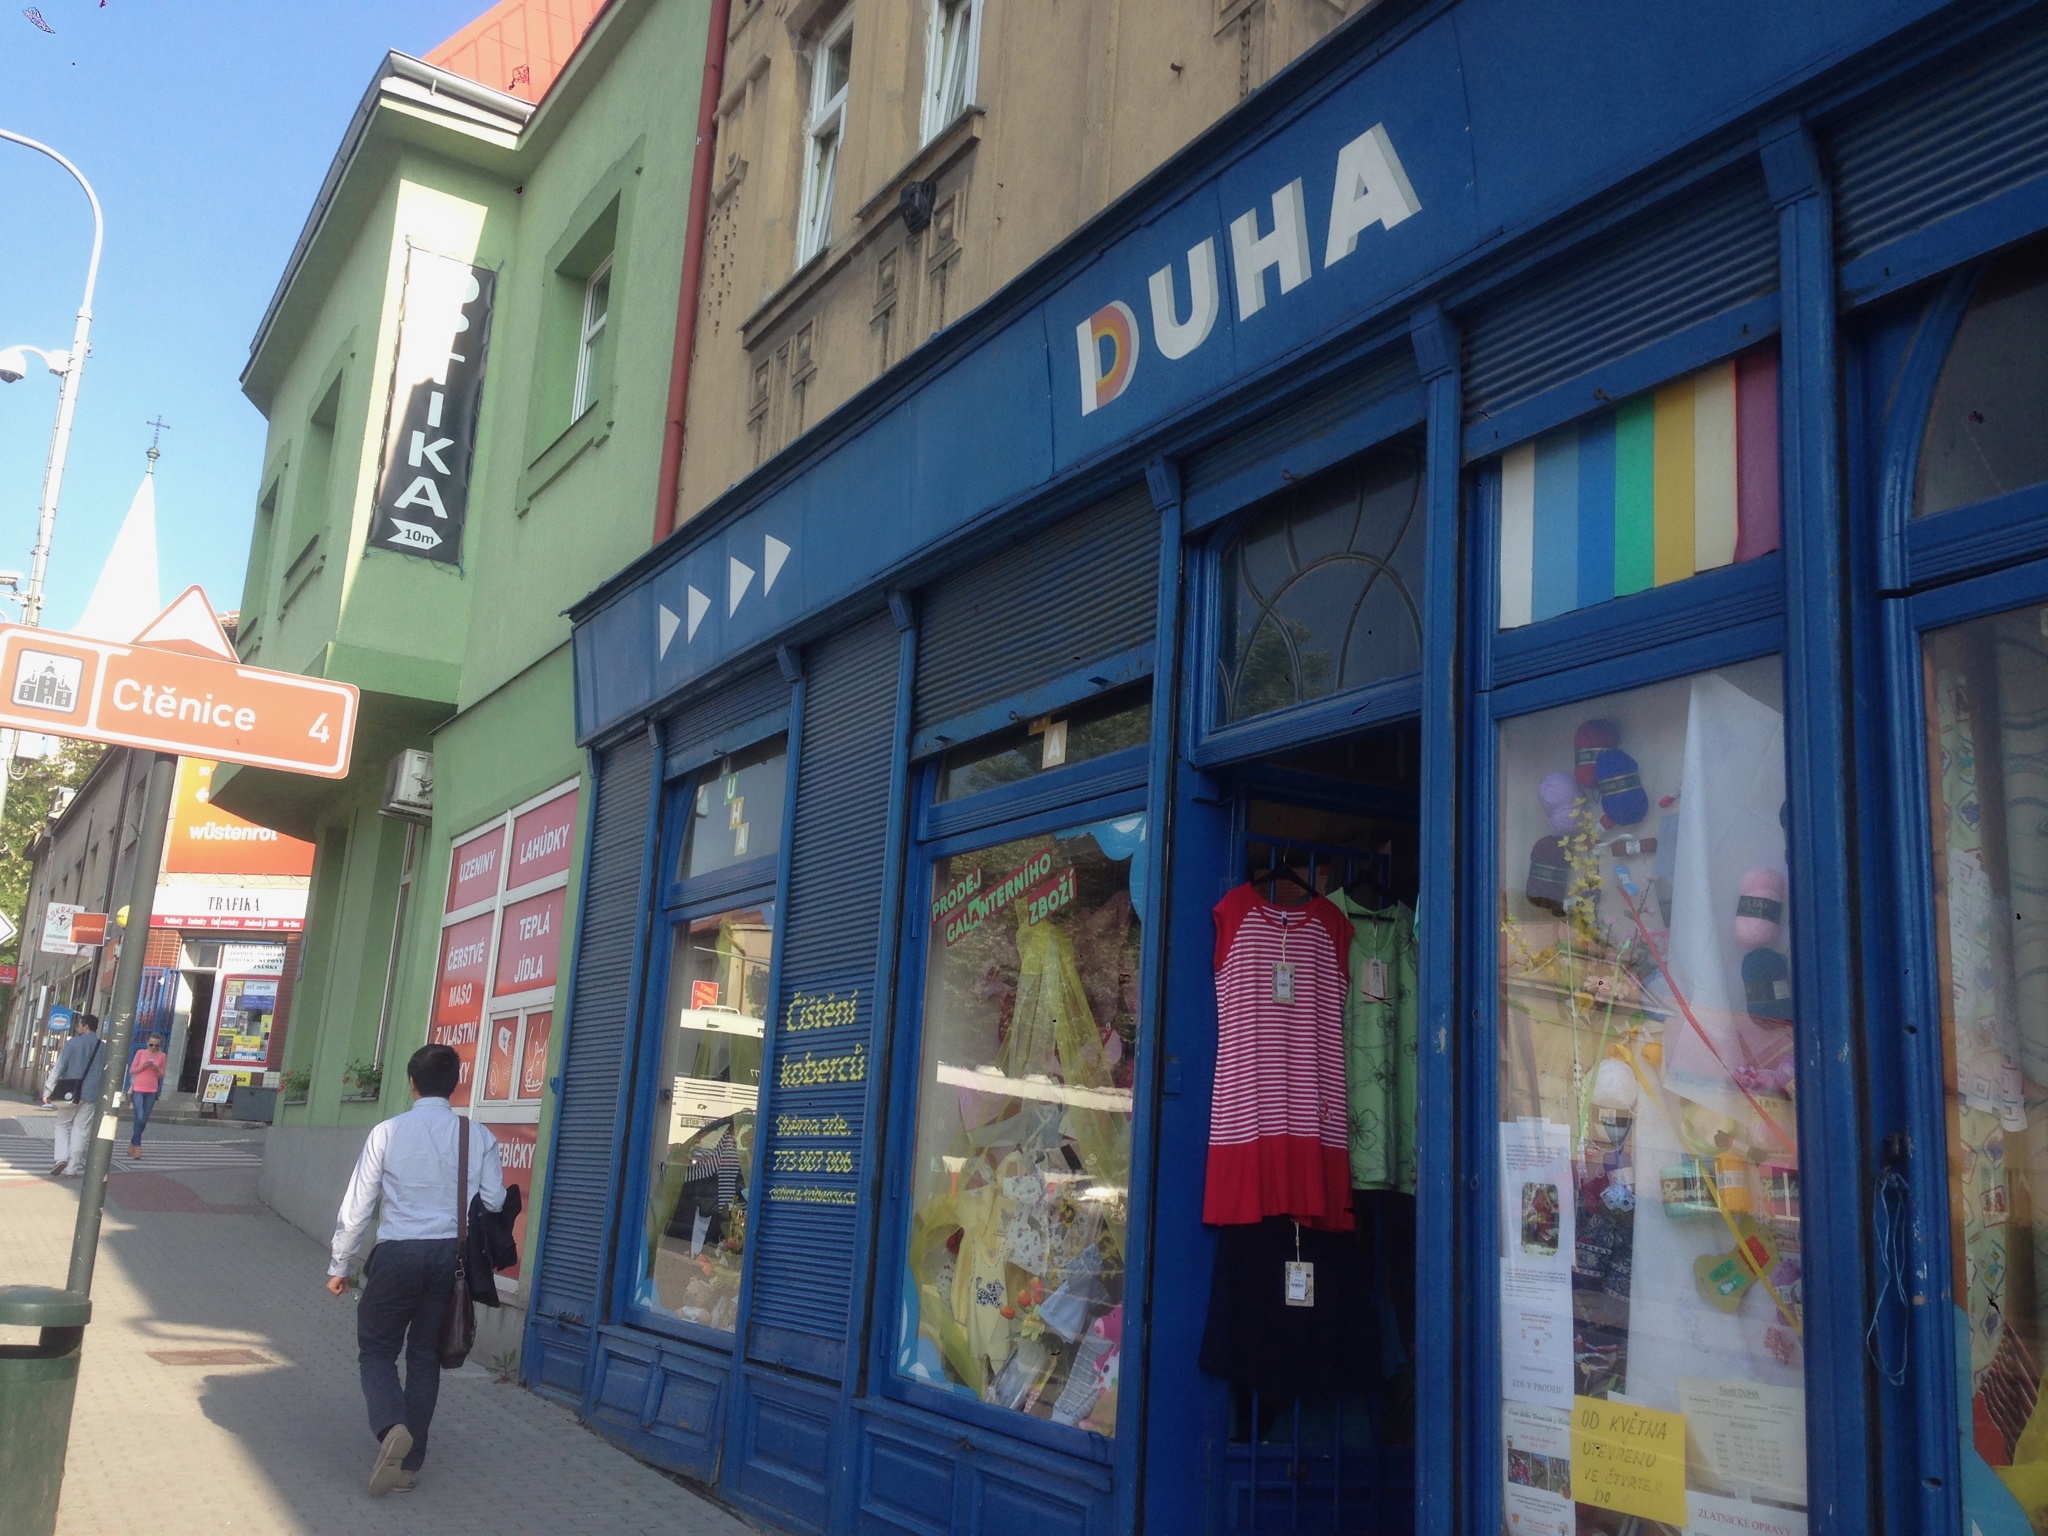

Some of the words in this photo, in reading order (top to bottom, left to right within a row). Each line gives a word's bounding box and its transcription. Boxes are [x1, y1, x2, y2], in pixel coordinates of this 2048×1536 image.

[1075, 121, 1422, 418] DUHA
[404, 528, 434, 545] 10m
[113, 678, 257, 731] Ctěnice
[308, 712, 330, 744] 4
[189, 821, 278, 841] wüstenrot
[519, 825, 570, 865] LAHŮDKY
[459, 849, 496, 883] UZENINY
[207, 896, 260, 912] TRAFIKA
[932, 868, 982, 921] PRODEJ
[946, 853, 1051, 944] GALANTERNÍHO
[1028, 869, 1075, 925] ZBOŽÍ
[518, 905, 551, 942] TEPLÁ
[447, 936, 484, 972] ČERSTVÉ
[514, 954, 543, 984] JÍDLA
[448, 982, 473, 1007] MASO
[786, 990, 859, 1032] Čištění
[434, 1027, 442, 1045] Z
[442, 1016, 478, 1047] VLASTNÍ
[209, 1074, 233, 1083] FOTO
[779, 1043, 865, 1089] koberců
[775, 1113, 820, 1136] Sběrna
[773, 1150, 797, 1171] 773
[798, 1150, 823, 1172] 007
[1736, 1388, 1760, 1400] DUHA
[1581, 1410, 1599, 1430] OD
[1609, 1410, 1668, 1440] KVĚTNA
[1584, 1467, 1598, 1483] VE
[1698, 1508, 1750, 1529] ZLATNICKÉ
[1751, 1520, 1792, 1536] OPRAVY
